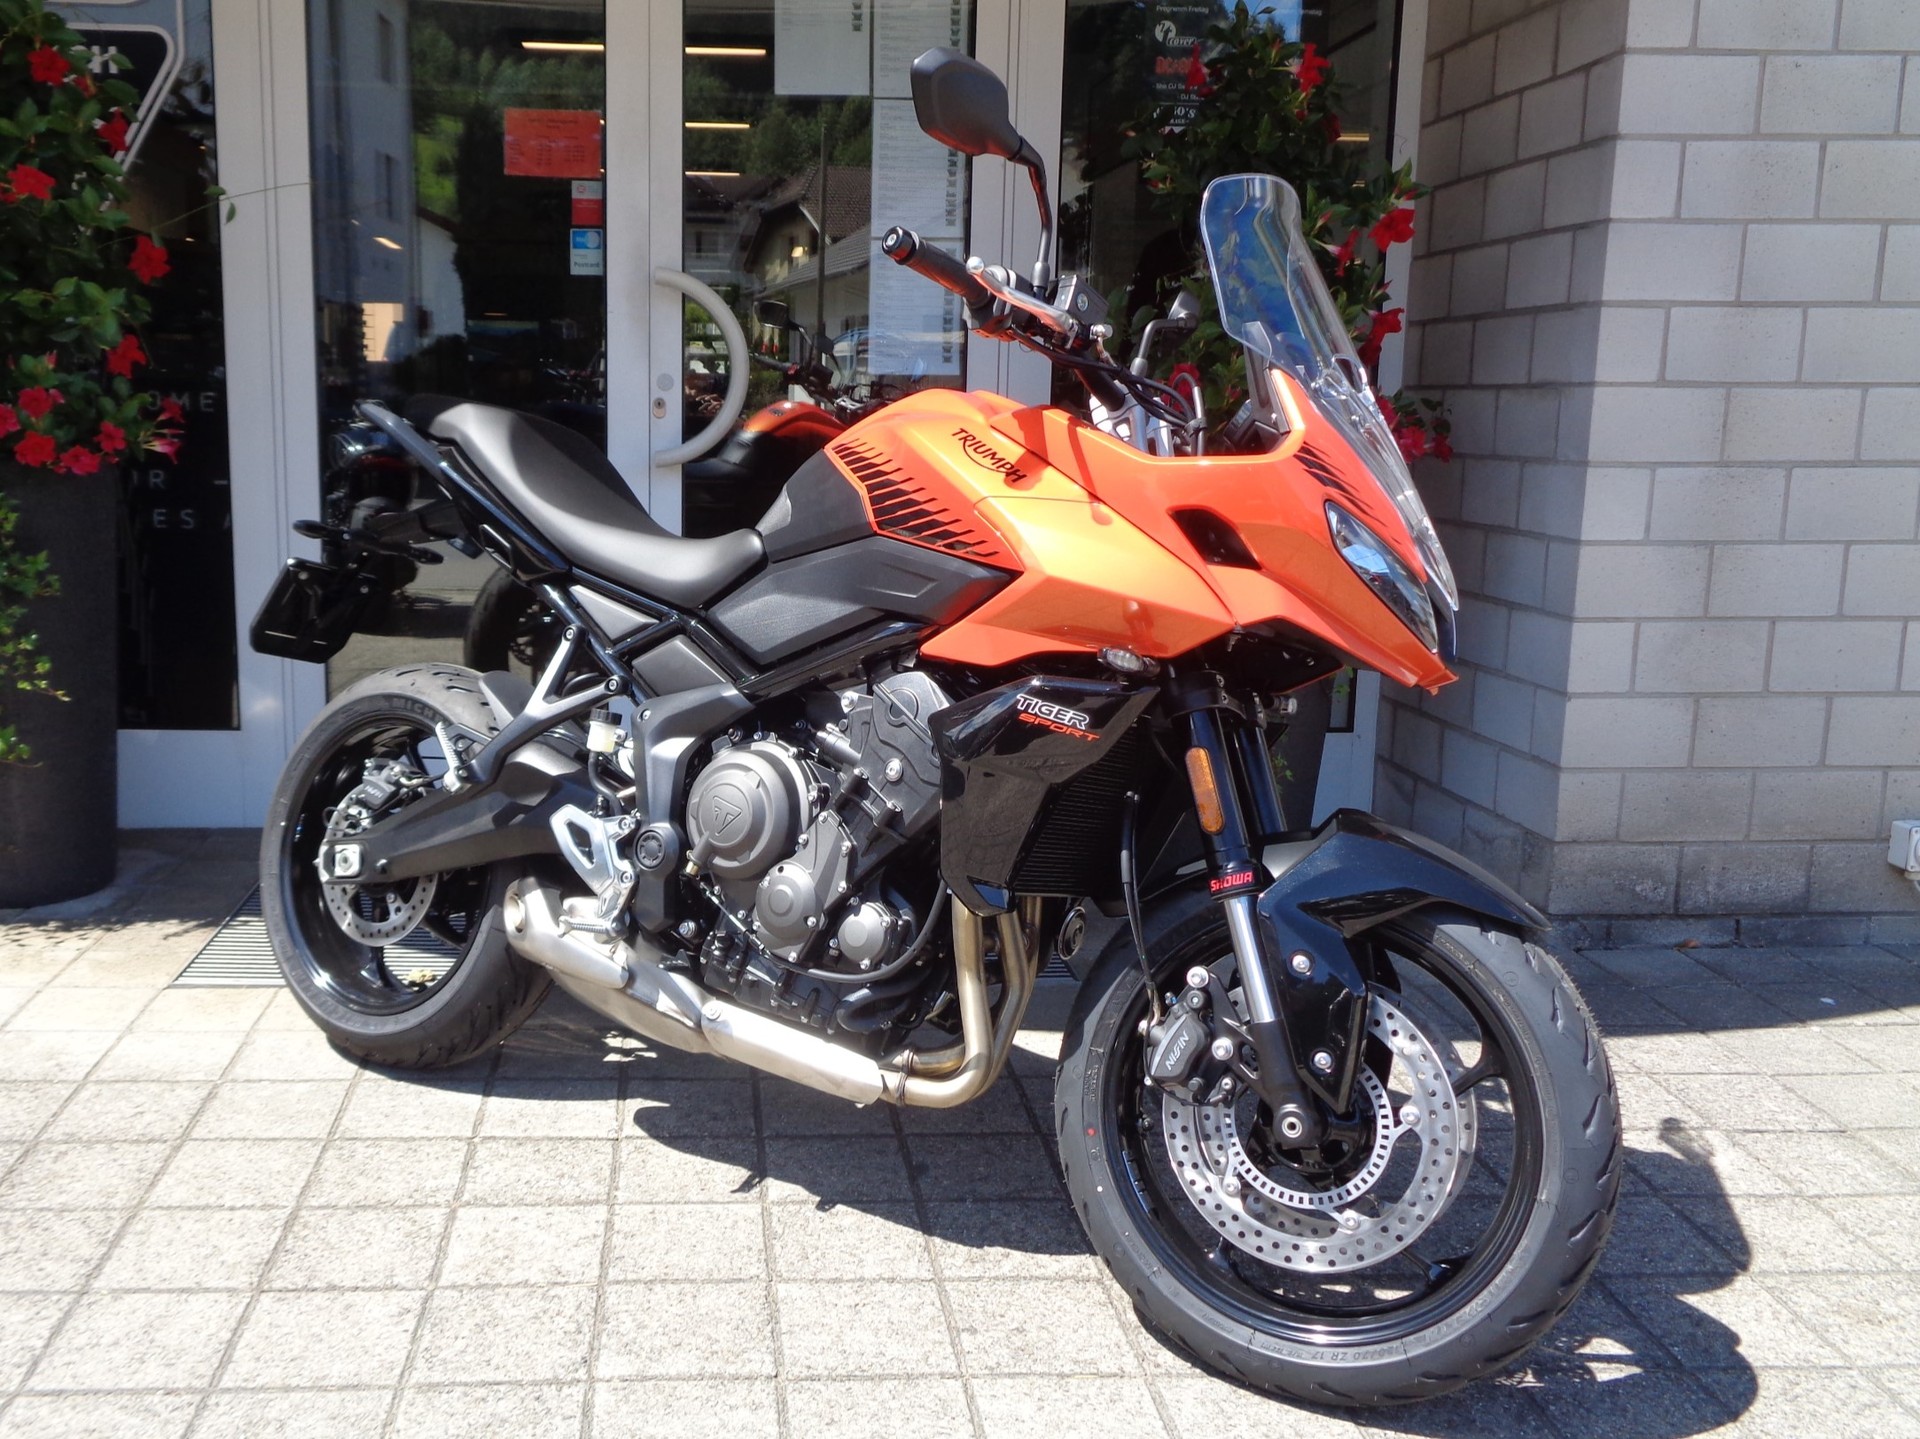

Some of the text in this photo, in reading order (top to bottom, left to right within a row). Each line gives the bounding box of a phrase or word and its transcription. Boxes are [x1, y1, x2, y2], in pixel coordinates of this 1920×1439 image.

[952, 428, 1027, 483] TRIUMPH
[1016, 693, 1089, 730] TIGER
[1018, 712, 1100, 741] SPORT
